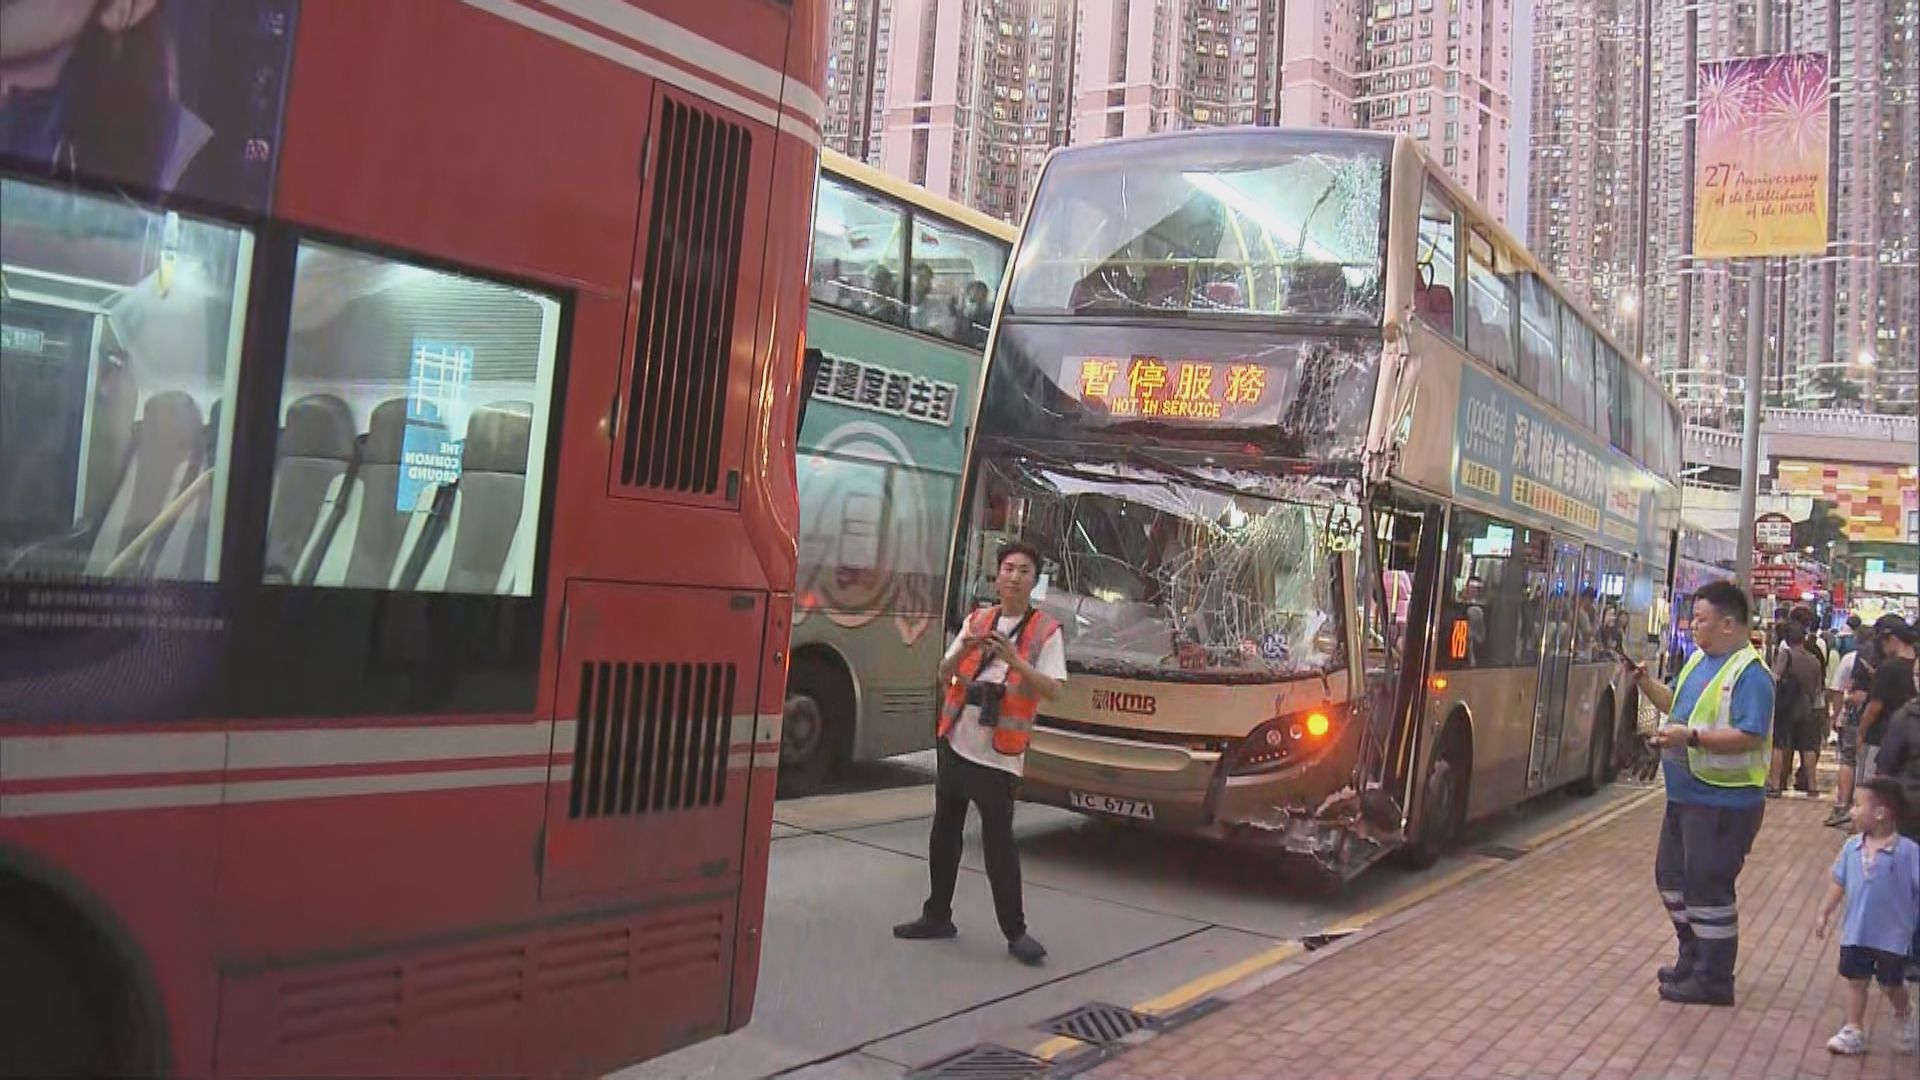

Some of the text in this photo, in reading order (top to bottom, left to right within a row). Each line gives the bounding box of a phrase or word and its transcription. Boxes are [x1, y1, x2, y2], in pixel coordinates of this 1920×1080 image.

[1736, 171, 1818, 189] Anniversary
[1716, 188, 1815, 207] of the Establishment
[1746, 201, 1816, 219] of the HKSAR
[1080, 359, 1266, 403] 暫停服務
[1112, 397, 1222, 418] NOT IN SERVICE
[1110, 691, 1157, 716] KMB
